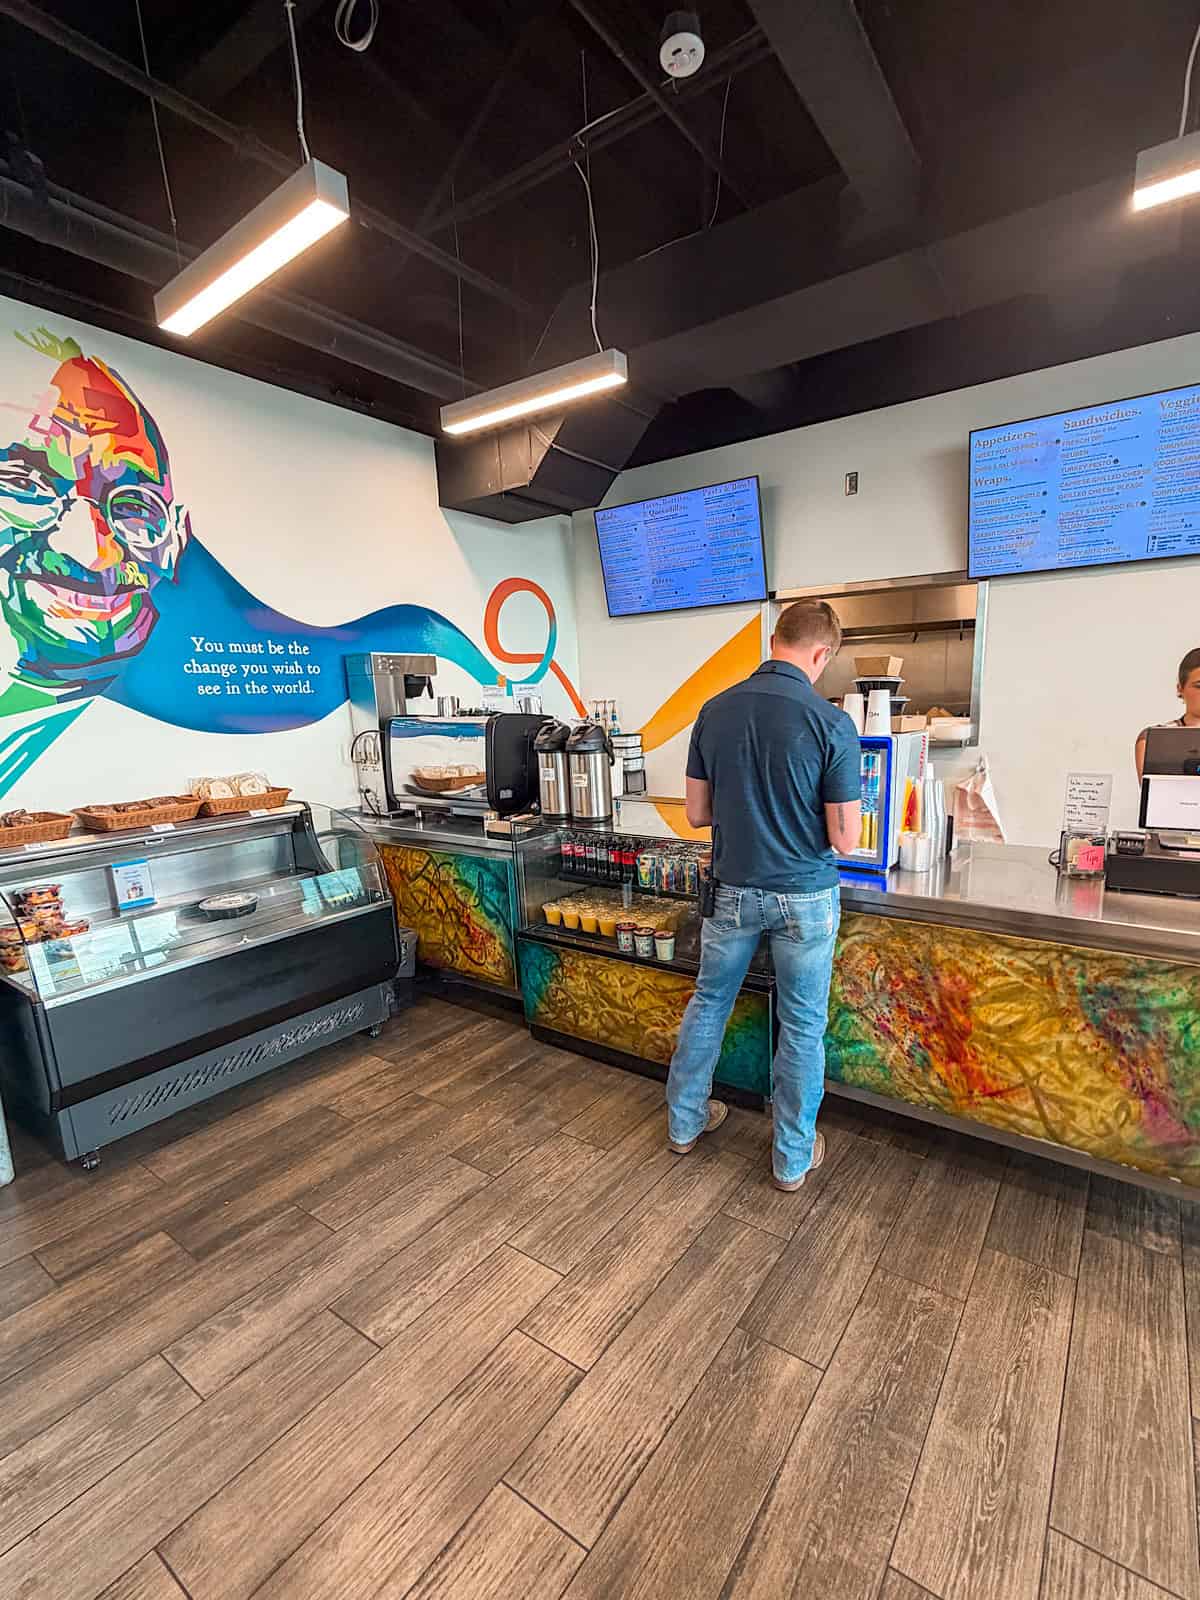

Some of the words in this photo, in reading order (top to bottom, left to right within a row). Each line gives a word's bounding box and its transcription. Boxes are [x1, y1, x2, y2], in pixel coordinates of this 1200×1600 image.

[1064, 410, 1142, 430] Sandwiches.
[974, 432, 1037, 448] Appetizers.
[974, 476, 1012, 488] Wraps.
[190, 636, 224, 653] You
[228, 640, 264, 654] must
[267, 640, 285, 654] be
[288, 641, 310, 655] the
[184, 659, 237, 678] change
[240, 664, 268, 678] you
[272, 660, 304, 674] wish
[307, 664, 321, 674] to
[198, 684, 222, 695] see
[226, 681, 240, 695] in
[244, 680, 268, 694] the
[272, 680, 314, 694] world.
[1081, 849, 1099, 864] Tips
